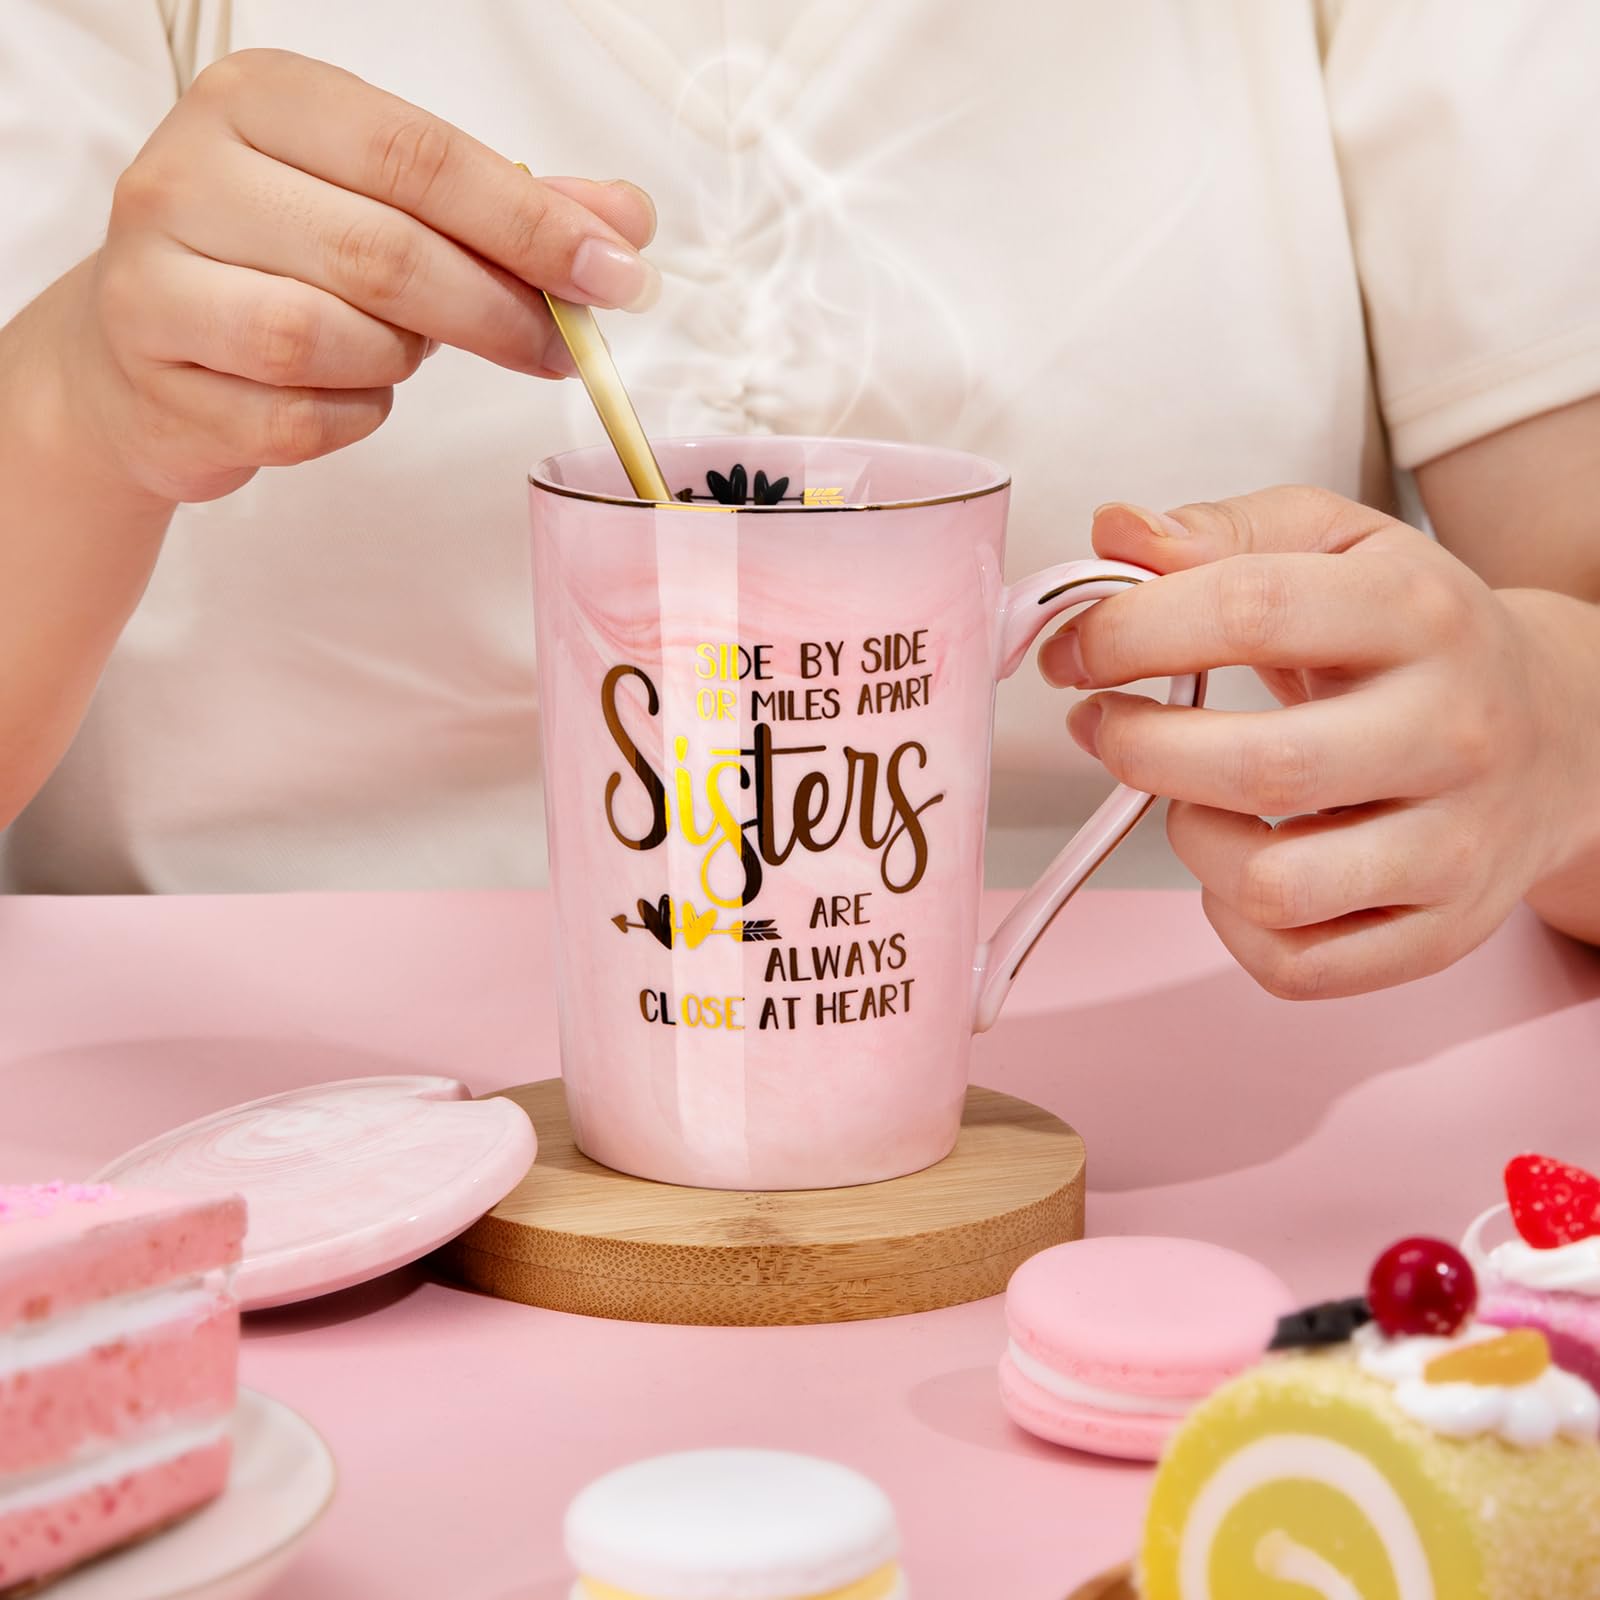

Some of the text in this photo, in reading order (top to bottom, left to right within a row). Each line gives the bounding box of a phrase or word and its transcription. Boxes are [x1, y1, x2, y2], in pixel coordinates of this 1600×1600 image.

[695, 629, 929, 681] SIDE BY SIDE
[696, 674, 933, 721] OR MILES APART
[601, 664, 945, 908] Sisters
[809, 893, 872, 929] ARE
[764, 933, 907, 982] ALWAYS
[639, 979, 915, 1030] CLOSE AT HEART
